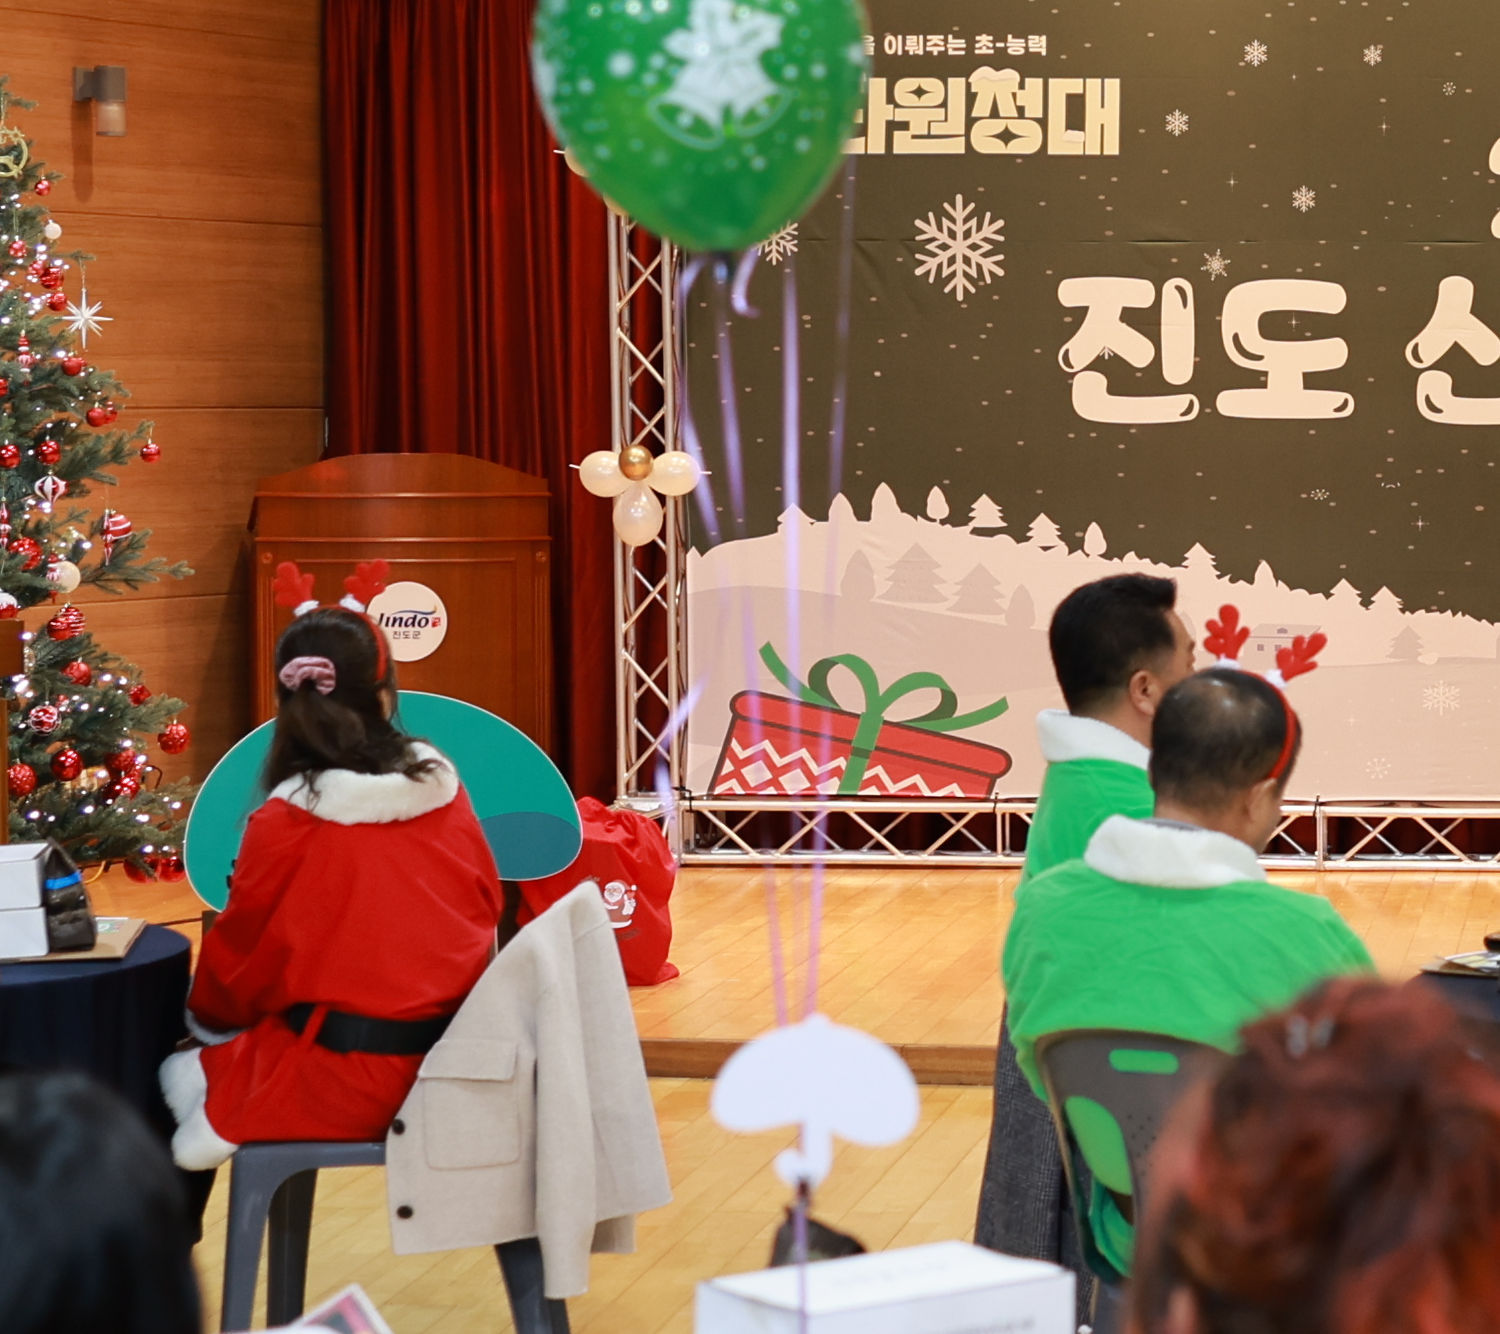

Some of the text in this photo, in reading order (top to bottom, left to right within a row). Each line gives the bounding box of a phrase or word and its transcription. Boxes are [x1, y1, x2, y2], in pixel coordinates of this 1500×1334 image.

[884, 34, 967, 56] 이뤄주는
[974, 33, 1048, 56] 초-능력
[1057, 276, 1357, 426] 진도
[392, 630, 421, 640] 진도군
